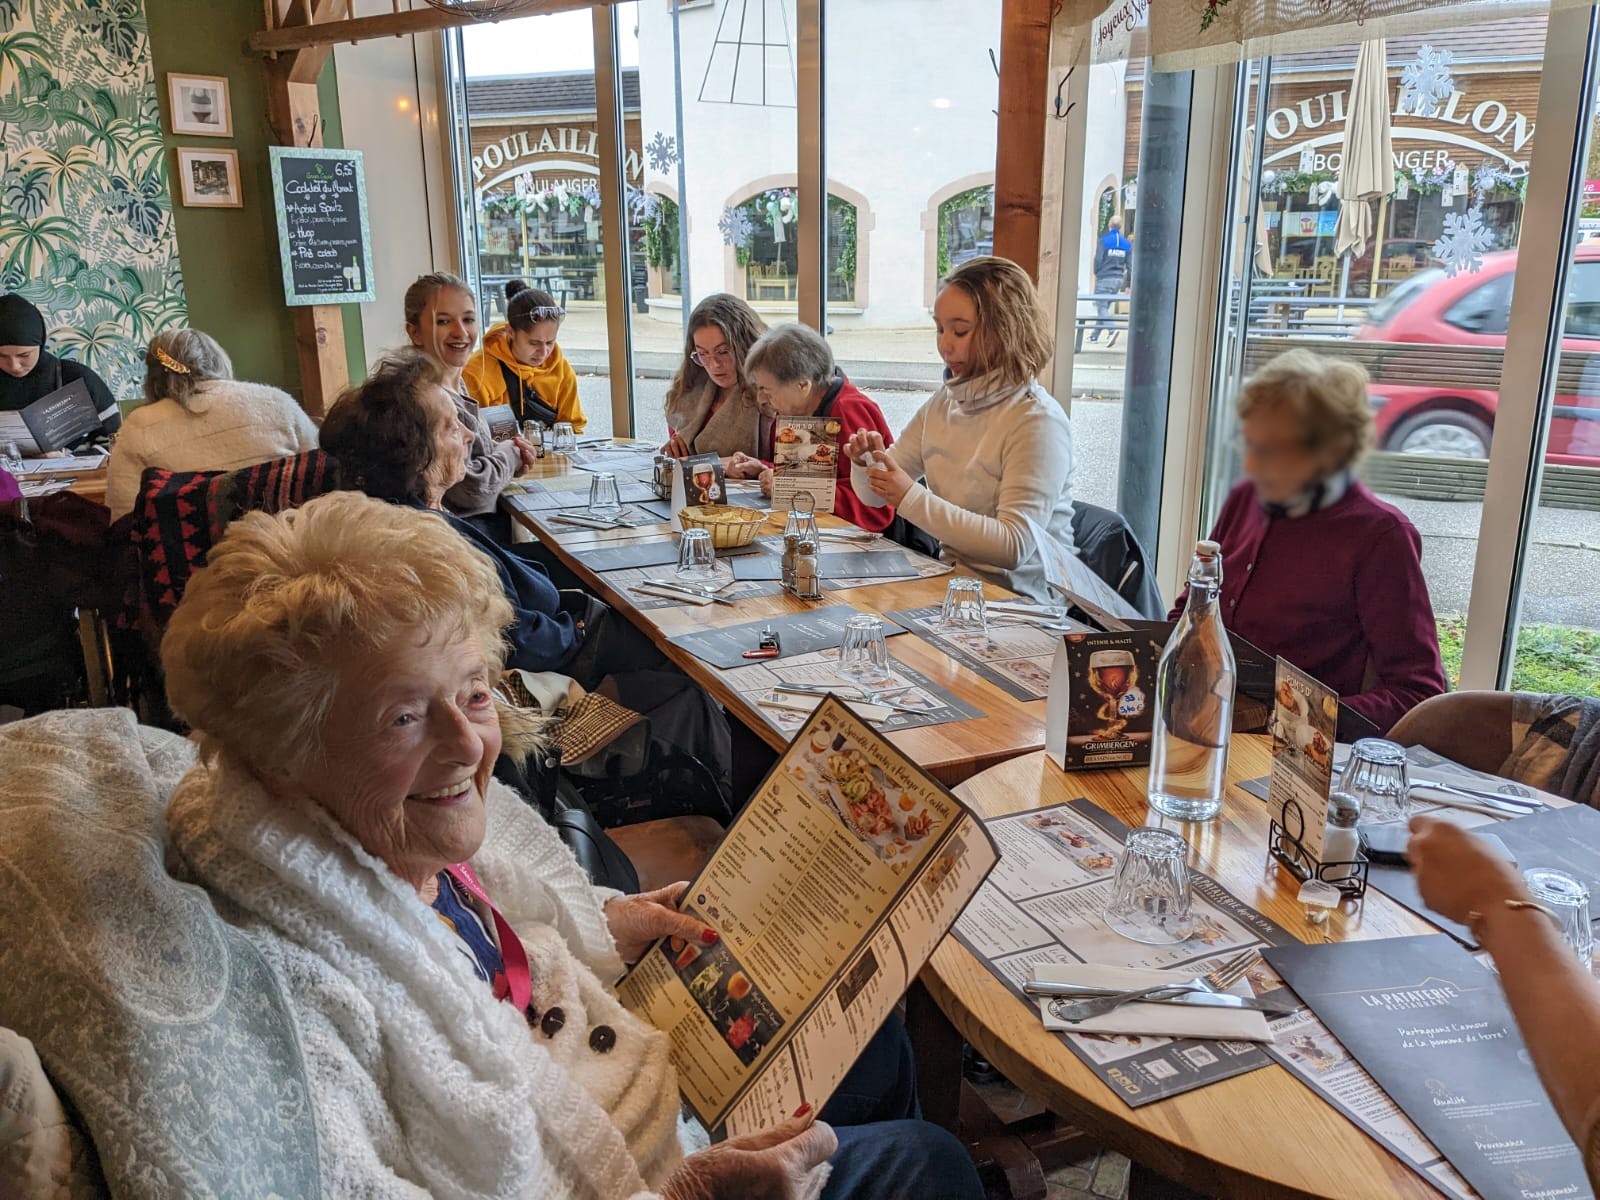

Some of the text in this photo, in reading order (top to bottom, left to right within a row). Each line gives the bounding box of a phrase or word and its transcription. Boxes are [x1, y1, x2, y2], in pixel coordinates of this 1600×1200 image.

[472, 128, 644, 183] POULAILLN
[1313, 150, 1449, 171] BONGER
[523, 178, 597, 194] OULANGER
[1124, 694, 1136, 702] 33
[1085, 740, 1135, 751] GRIMBERGEN
[1199, 880, 1241, 909] PATATERIE
[1360, 986, 1460, 1007] LA PATATERIE
[1397, 1025, 1450, 1039] Partageons
[1402, 1039, 1414, 1049] de
[1415, 1039, 1427, 1047] la
[1429, 1038, 1464, 1049] pomme
[1466, 1033, 1479, 1043] de
[1478, 1031, 1503, 1042] terre
[1433, 1095, 1467, 1106] Qualité
[1475, 1139, 1526, 1151] Provenance
[1520, 1184, 1580, 1200] Engagement
